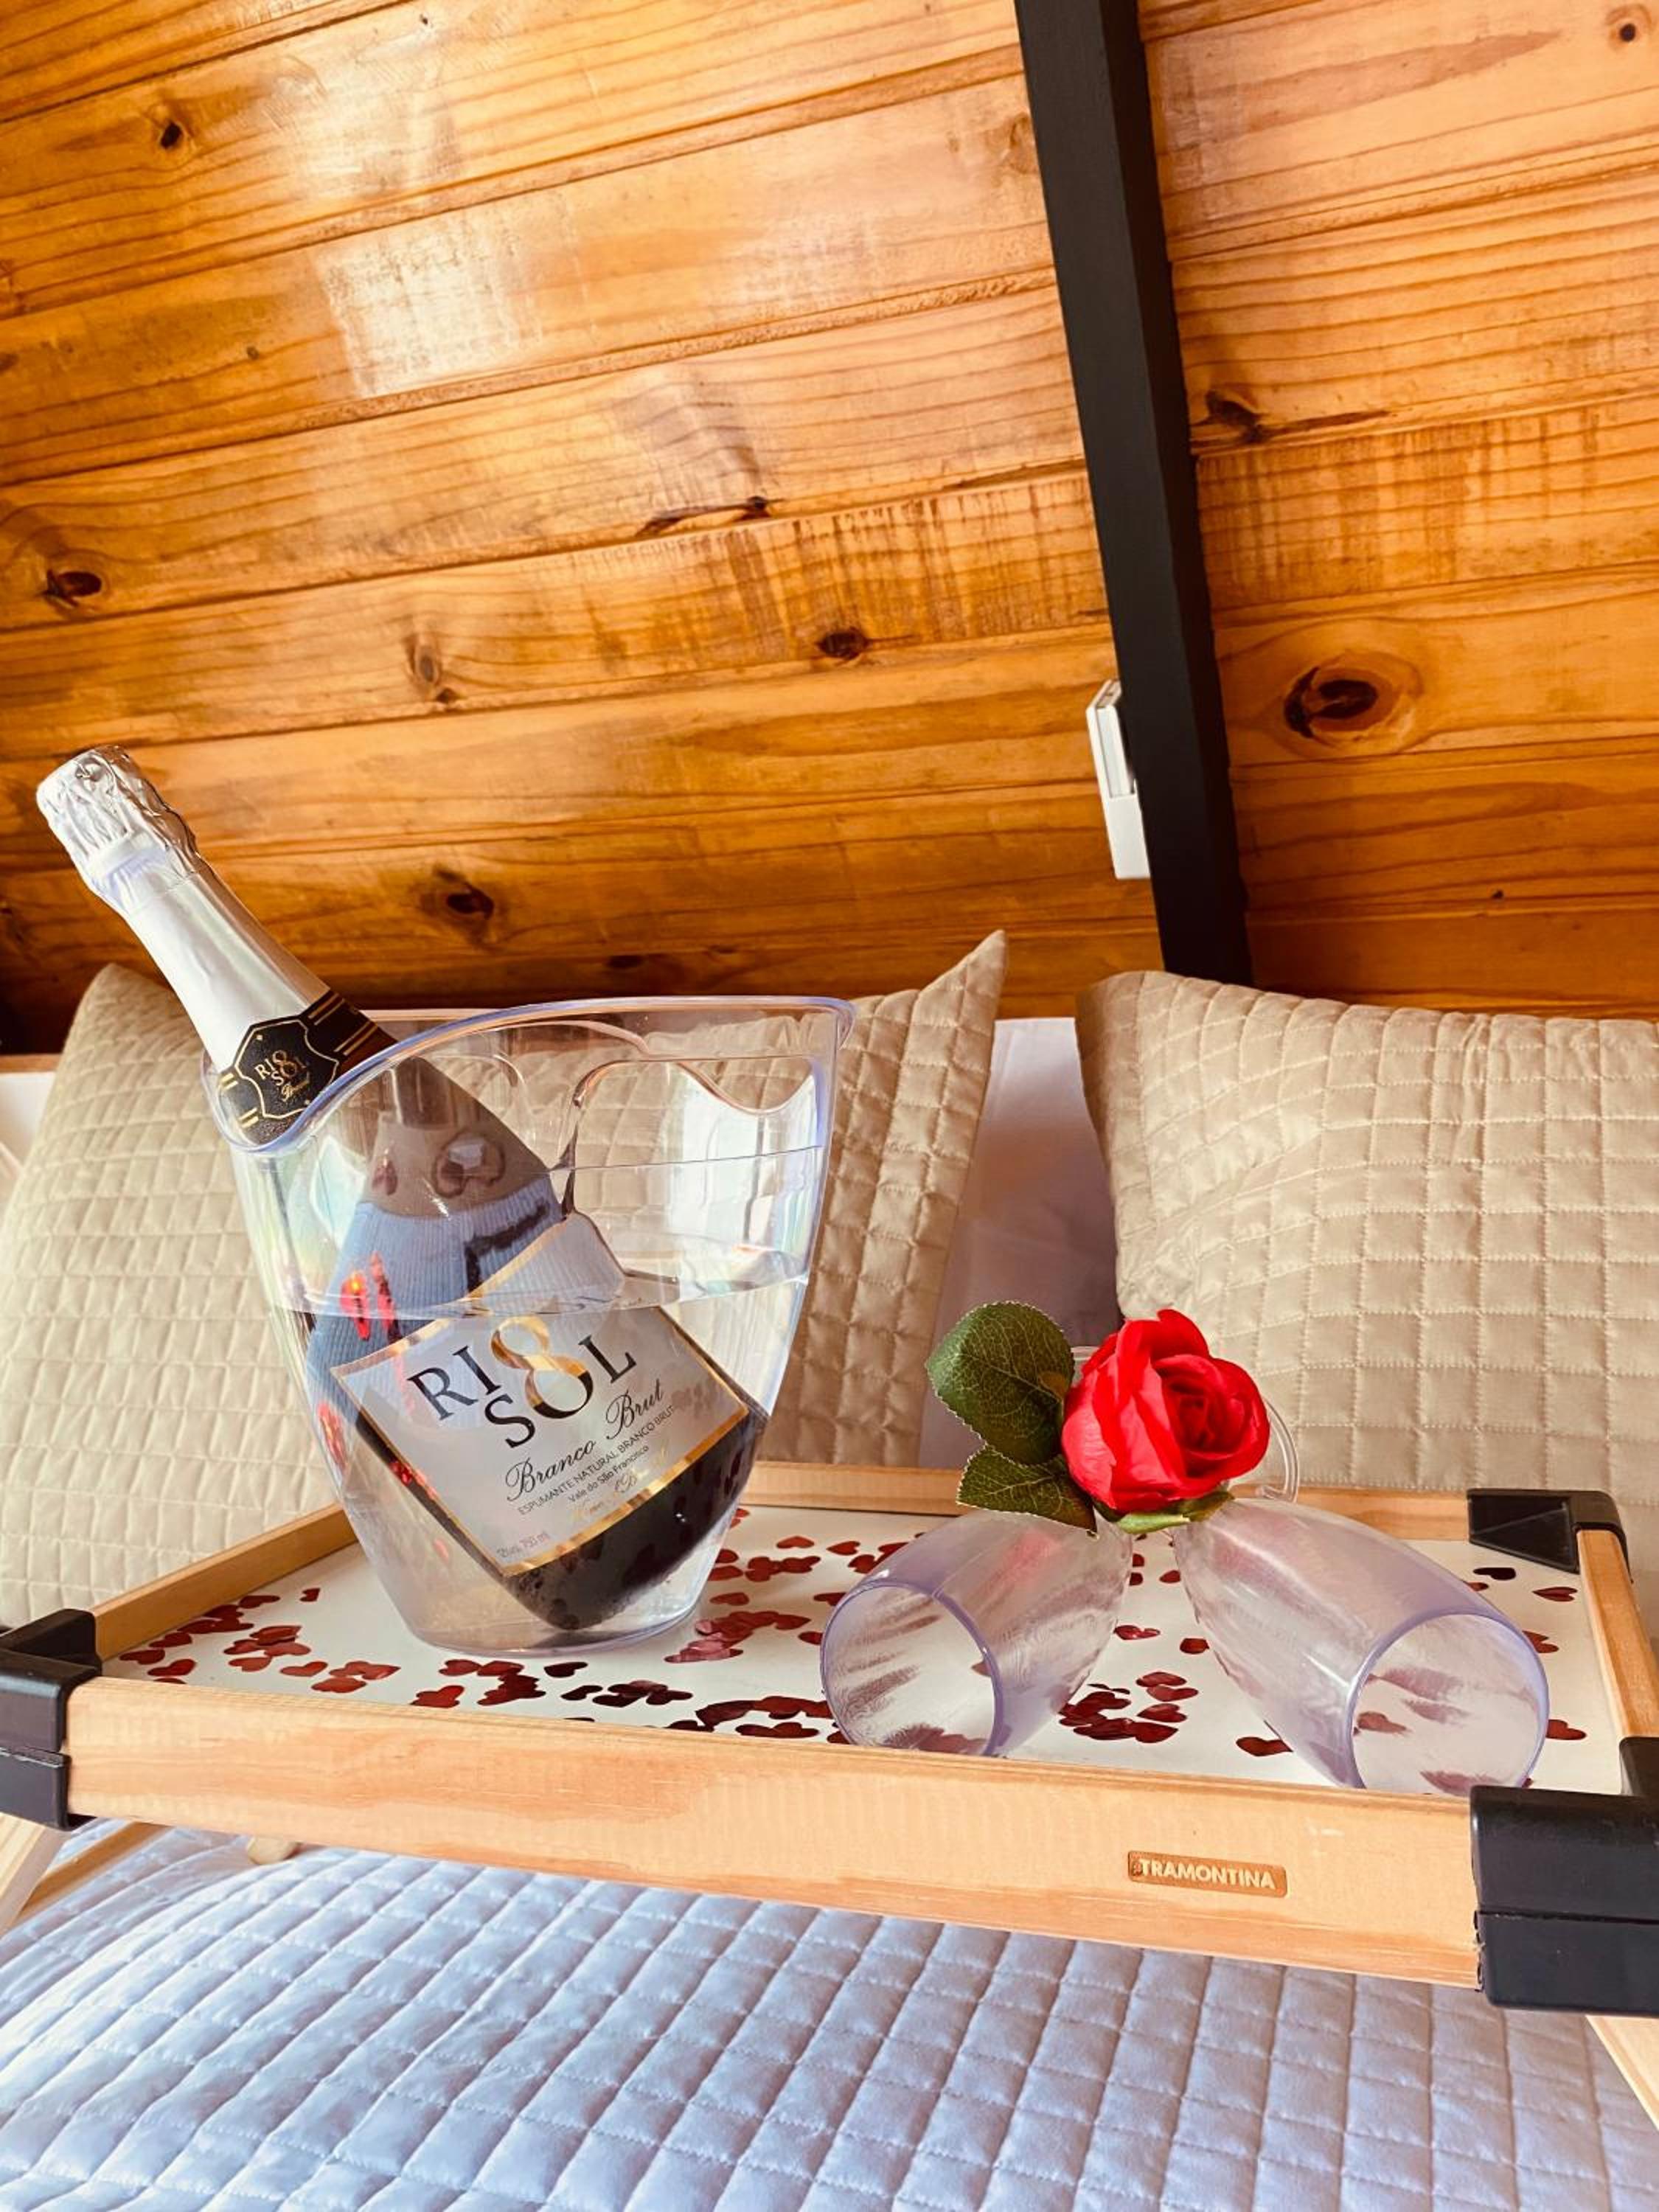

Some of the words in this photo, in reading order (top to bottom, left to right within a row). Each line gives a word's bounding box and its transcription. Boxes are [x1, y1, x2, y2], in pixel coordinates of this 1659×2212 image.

[505, 1439, 596, 1501] Branco
[605, 1378, 664, 1440] Brut
[518, 1478, 574, 1514] ESPUMANTE
[574, 1449, 619, 1483] NATURAL
[617, 1422, 655, 1453] BRANCO
[654, 1405, 674, 1425] BRUT
[597, 1470, 614, 1485] São
[1140, 1857, 1276, 1890] TRAMONTINA
